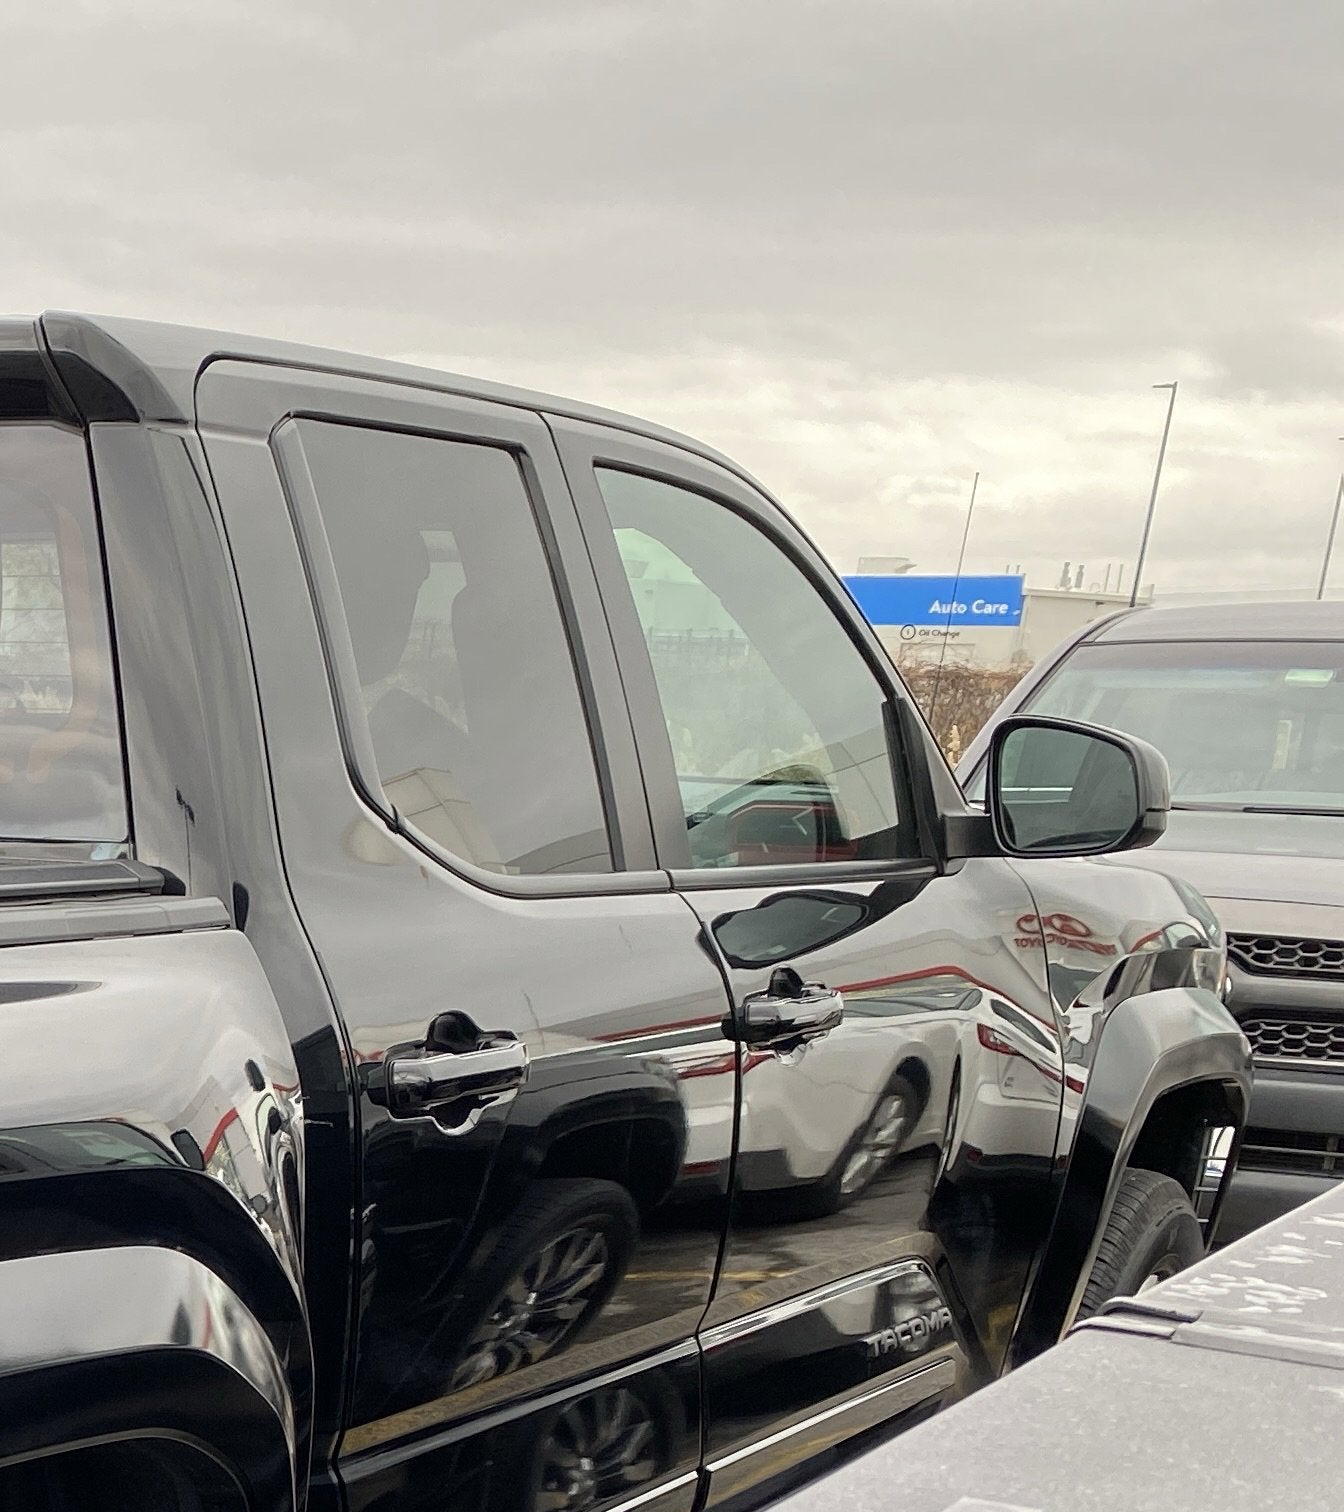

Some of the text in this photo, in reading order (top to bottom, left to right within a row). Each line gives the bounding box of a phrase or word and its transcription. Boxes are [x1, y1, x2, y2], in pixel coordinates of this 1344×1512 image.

[928, 600, 1009, 614] Auto Care
[863, 1307, 953, 1357] TACOMA
